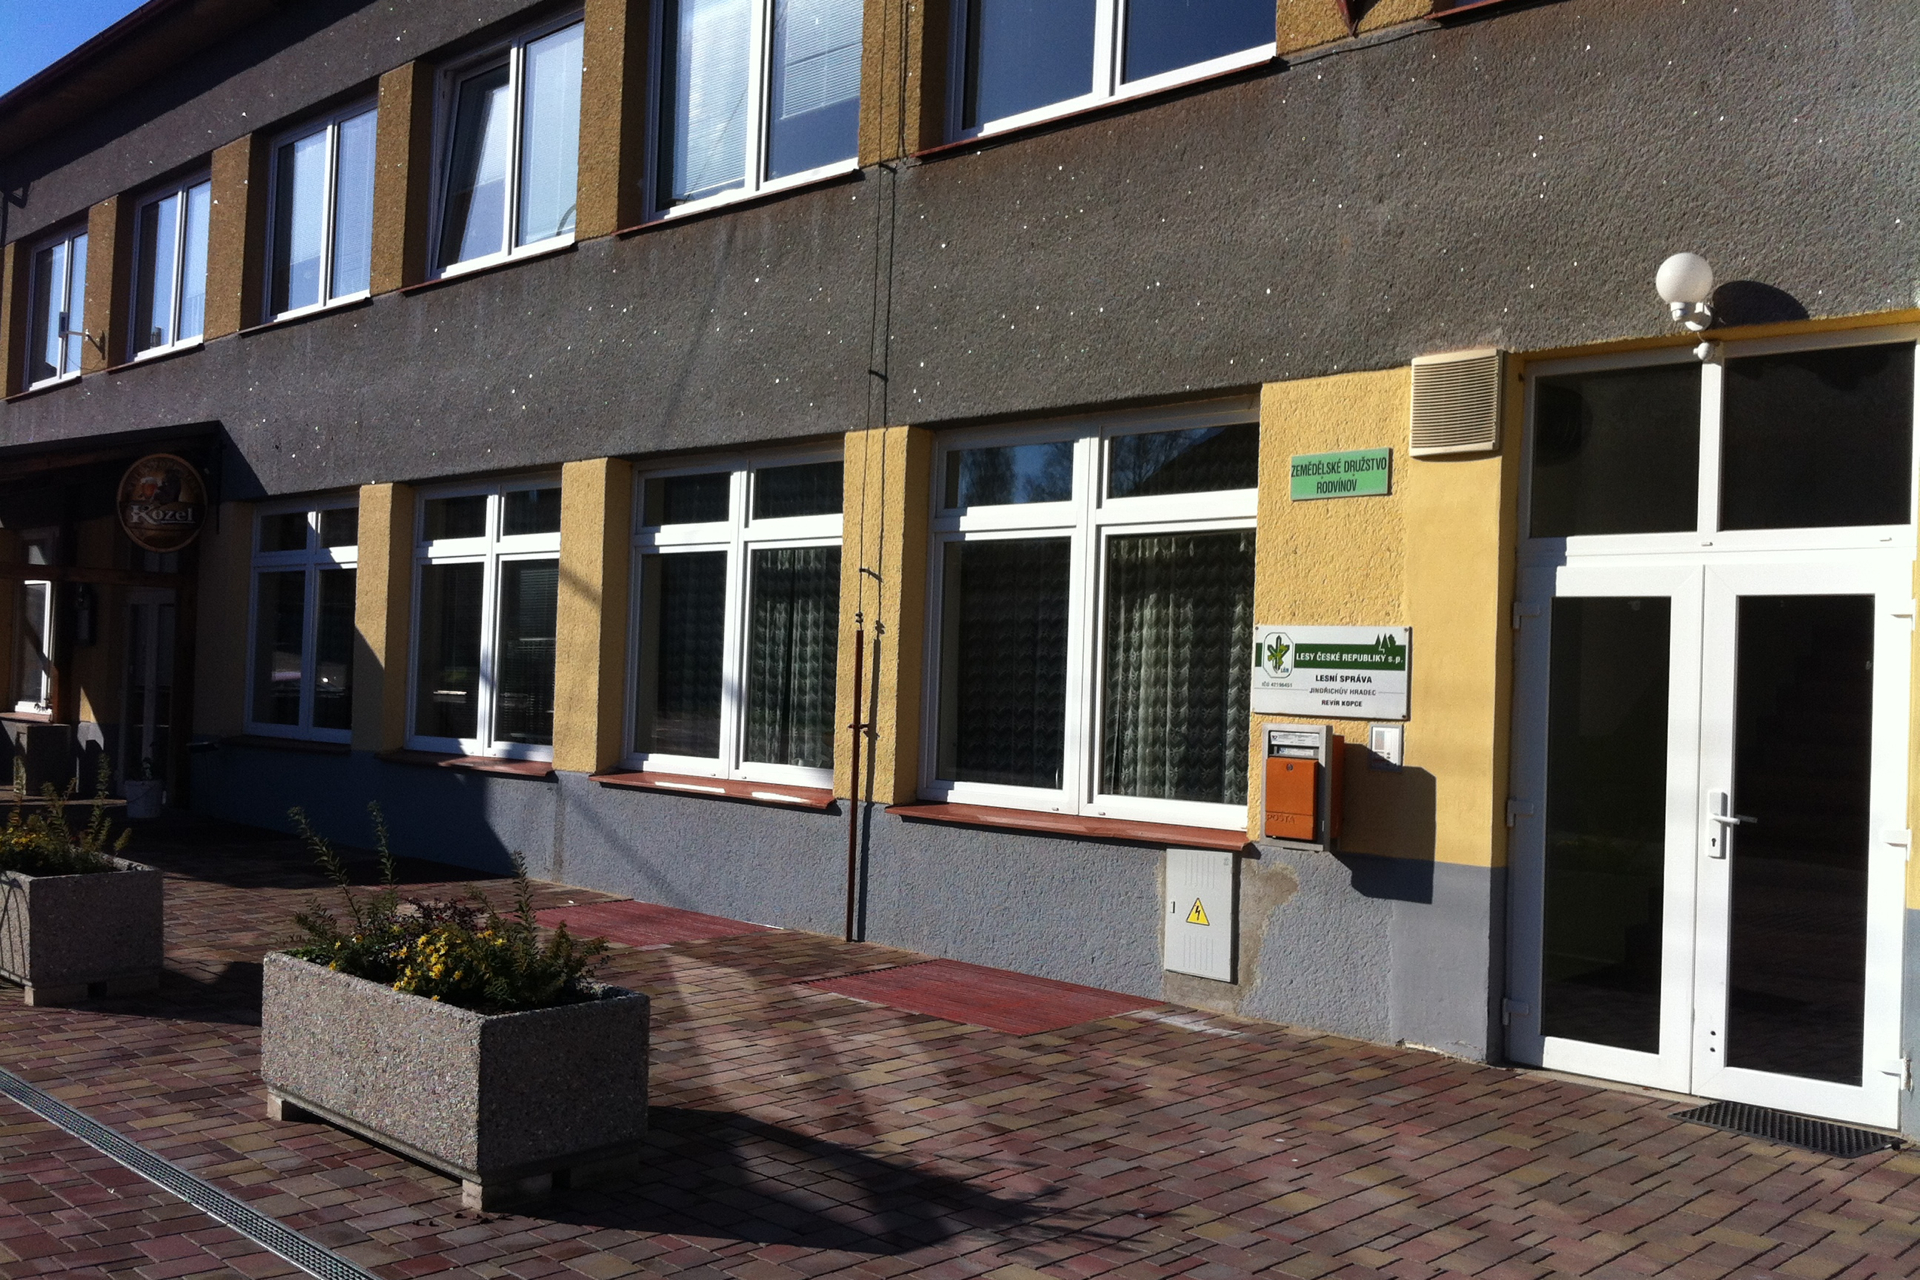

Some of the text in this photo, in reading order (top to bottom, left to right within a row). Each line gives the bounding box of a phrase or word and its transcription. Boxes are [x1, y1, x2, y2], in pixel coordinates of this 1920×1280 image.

[1291, 456, 1387, 477] ZEMĚDĚLSKÉ DRUŽSTVO
[1316, 477, 1357, 494] RODVÍNOV
[130, 504, 195, 525] Kozel
[1296, 652, 1315, 661] LESY
[1316, 651, 1340, 662] ČESKÉ
[1342, 653, 1386, 663] REPUBLIKY
[1315, 673, 1372, 683] LESNÍ SPRÁVA
[1349, 688, 1376, 696] HRADEC
[1321, 698, 1340, 706] REVÍR
